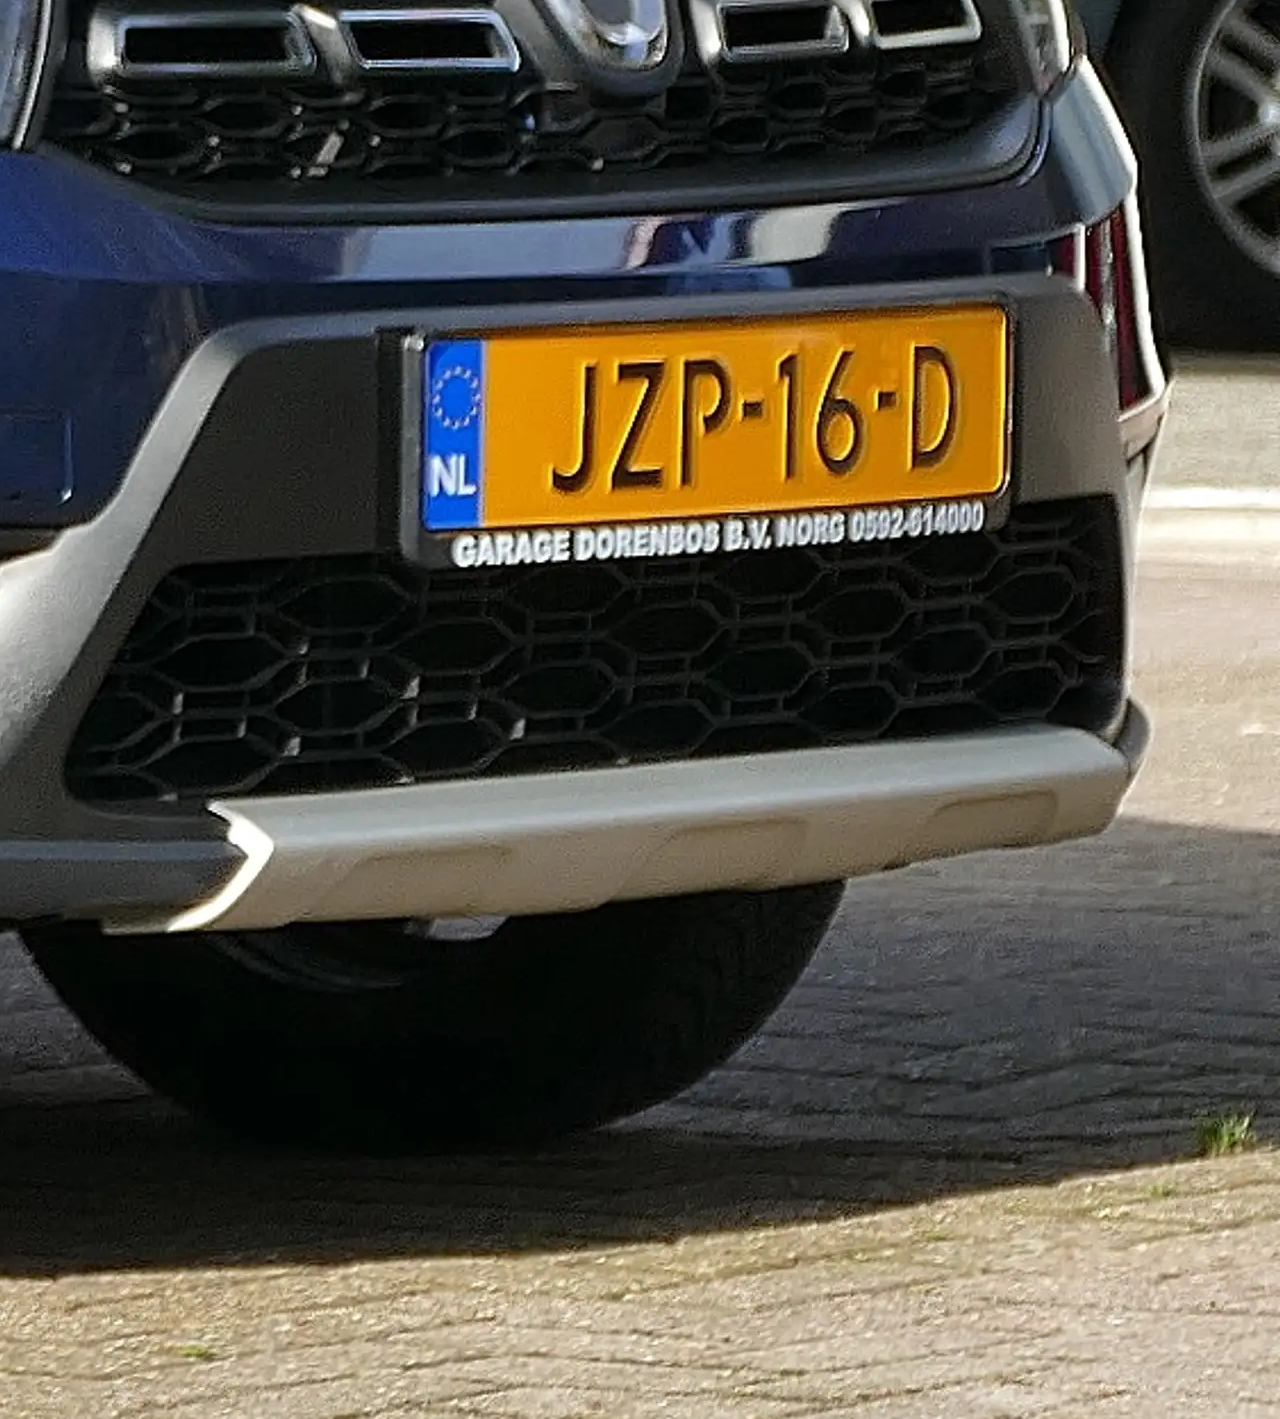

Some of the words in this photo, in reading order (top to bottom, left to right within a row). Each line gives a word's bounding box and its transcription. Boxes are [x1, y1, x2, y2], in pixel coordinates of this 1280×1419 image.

[550, 344, 958, 494] JZP-16-D
[429, 454, 477, 499] NL
[452, 530, 570, 568] GARAGE
[572, 521, 720, 561] DORENBOS
[723, 518, 772, 552] B.V.
[774, 512, 845, 548] NORG
